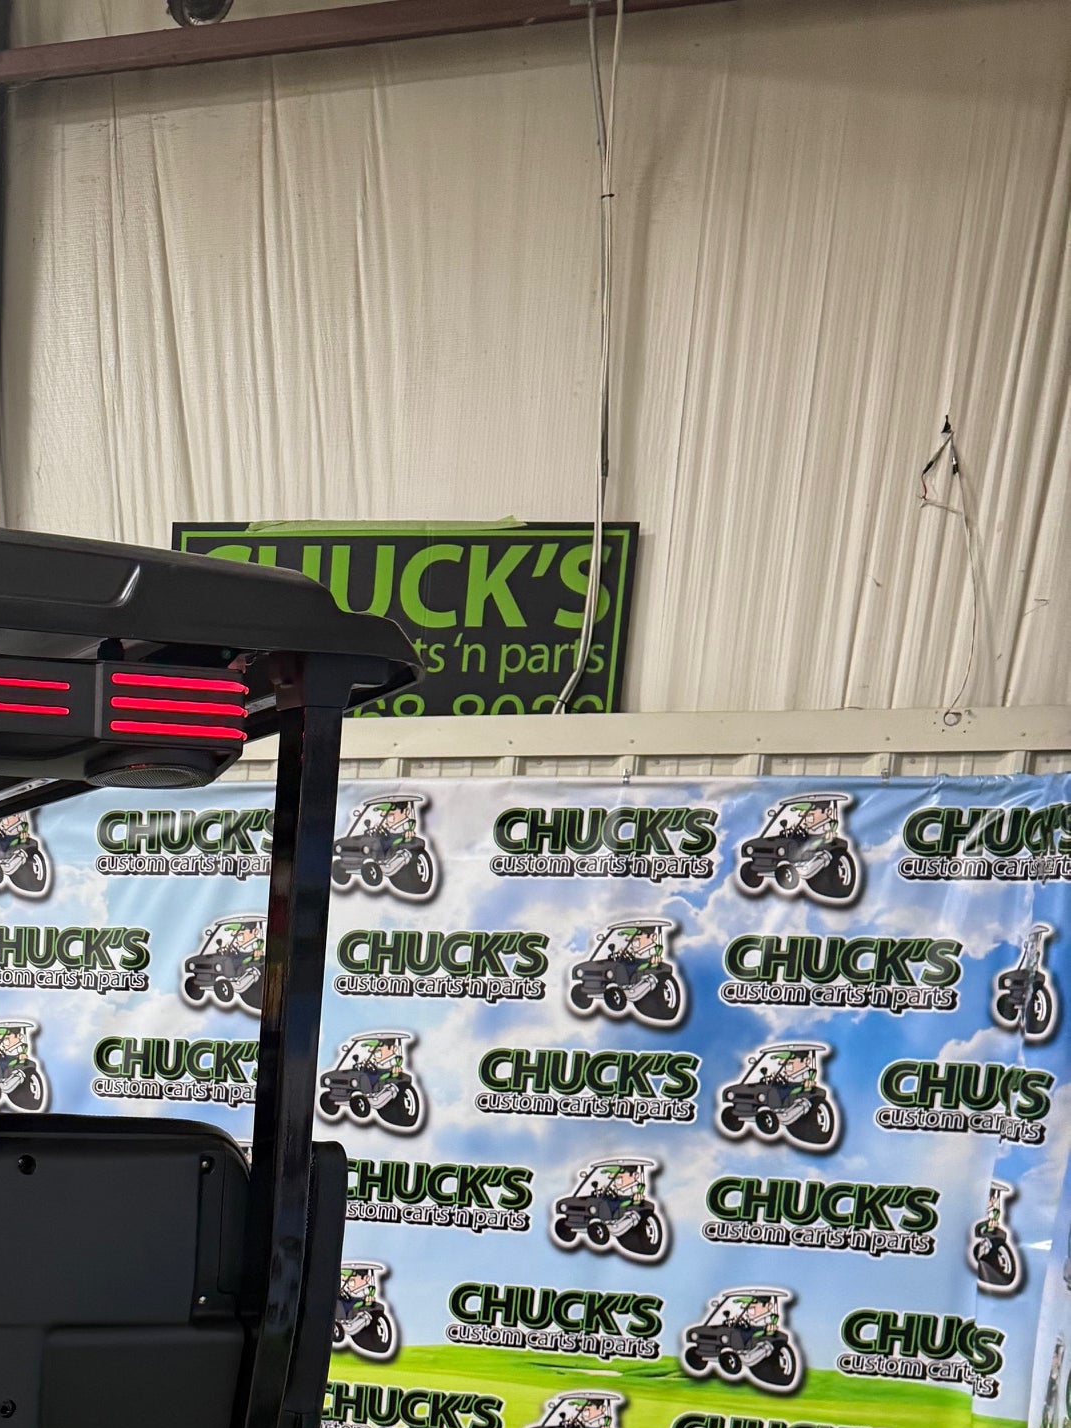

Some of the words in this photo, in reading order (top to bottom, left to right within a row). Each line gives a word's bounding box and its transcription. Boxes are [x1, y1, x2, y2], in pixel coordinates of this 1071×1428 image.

[205, 544, 610, 629] UCK'S
[499, 643, 605, 683] parts
[493, 808, 719, 856] CHUCK'S
[96, 855, 167, 874] custom
[236, 857, 271, 880] par
[490, 855, 572, 875] custom
[651, 857, 712, 881] parts
[898, 857, 990, 879] custom
[337, 930, 550, 977] CHUCK'S
[724, 935, 962, 987] CHUCK'S
[97, 970, 148, 992] parts
[334, 975, 411, 995] custom
[486, 978, 544, 1001] parts
[721, 983, 808, 1003] custom
[890, 986, 956, 1012] parts
[93, 1036, 260, 1083] CHUCK'
[479, 1048, 699, 1099] CHUCK'S
[92, 1078, 162, 1098] custom
[476, 1093, 556, 1114] custom
[633, 1098, 695, 1123] parts
[876, 1108, 966, 1131] custom
[346, 1202, 399, 1223] stom
[472, 1208, 529, 1233] parts
[706, 1176, 940, 1233] CHUCK'S
[703, 1221, 789, 1244] custom
[869, 1230, 933, 1256] parts
[448, 1282, 664, 1337] CHUCK'S
[446, 1324, 524, 1348] custom
[600, 1335, 659, 1360] parts
[837, 1354, 926, 1379] custom
